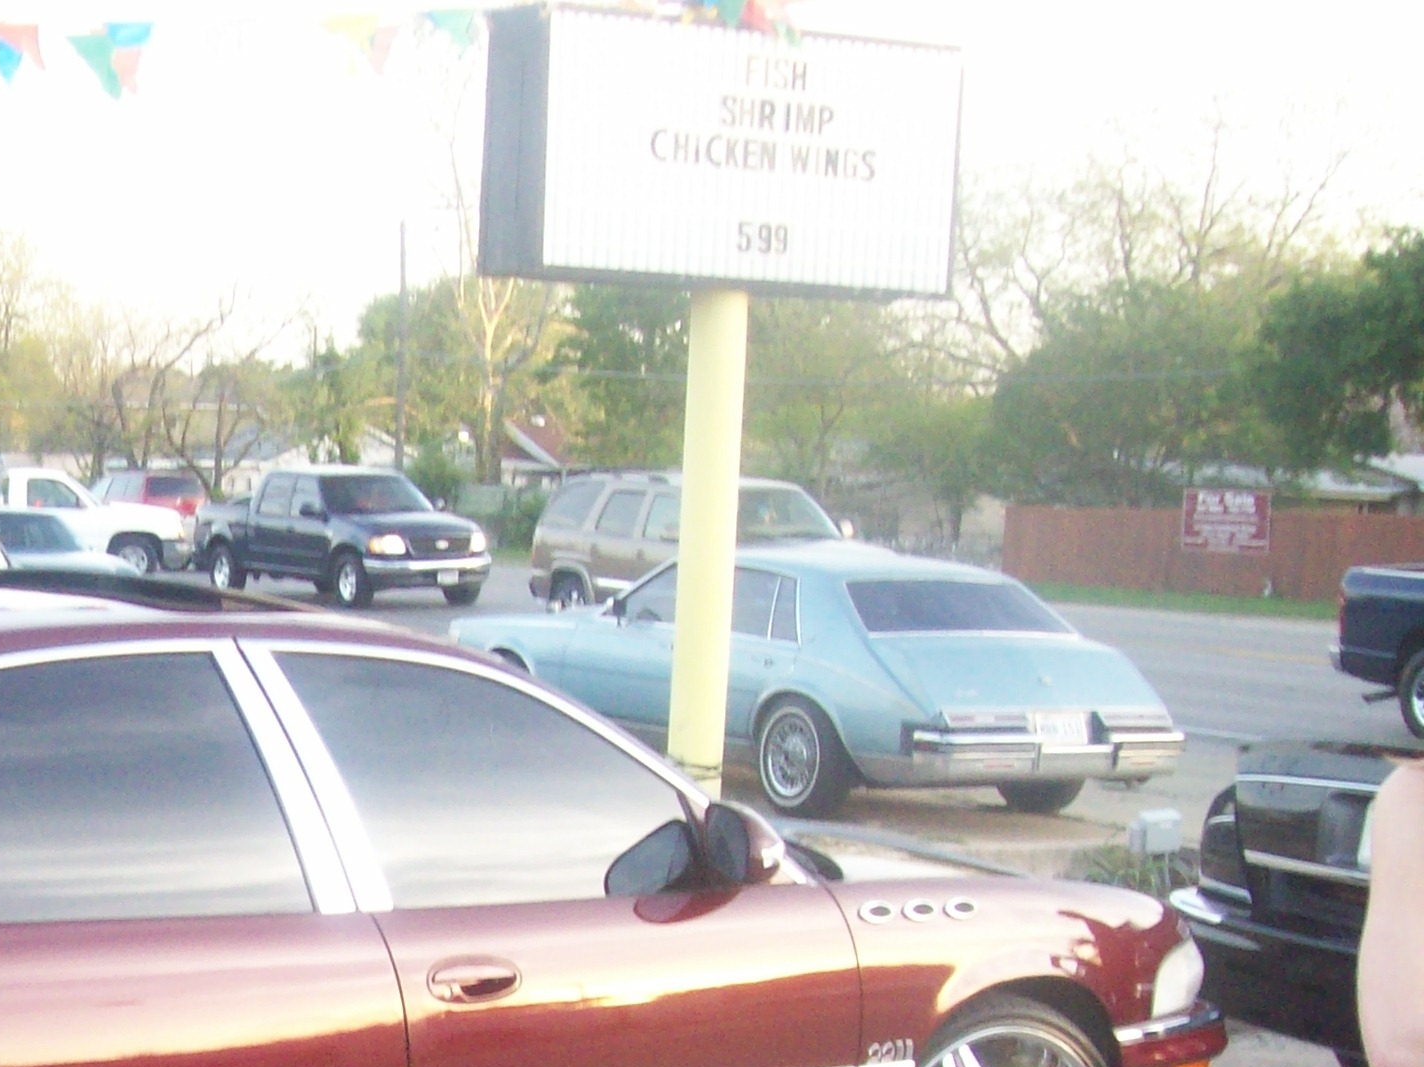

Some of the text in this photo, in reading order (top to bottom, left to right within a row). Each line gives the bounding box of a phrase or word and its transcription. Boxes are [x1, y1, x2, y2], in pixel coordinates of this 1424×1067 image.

[746, 55, 808, 91] FISH
[721, 95, 834, 135] SHRIMP
[650, 128, 876, 182] CHICKEN WINGS
[736, 221, 789, 254] 599
